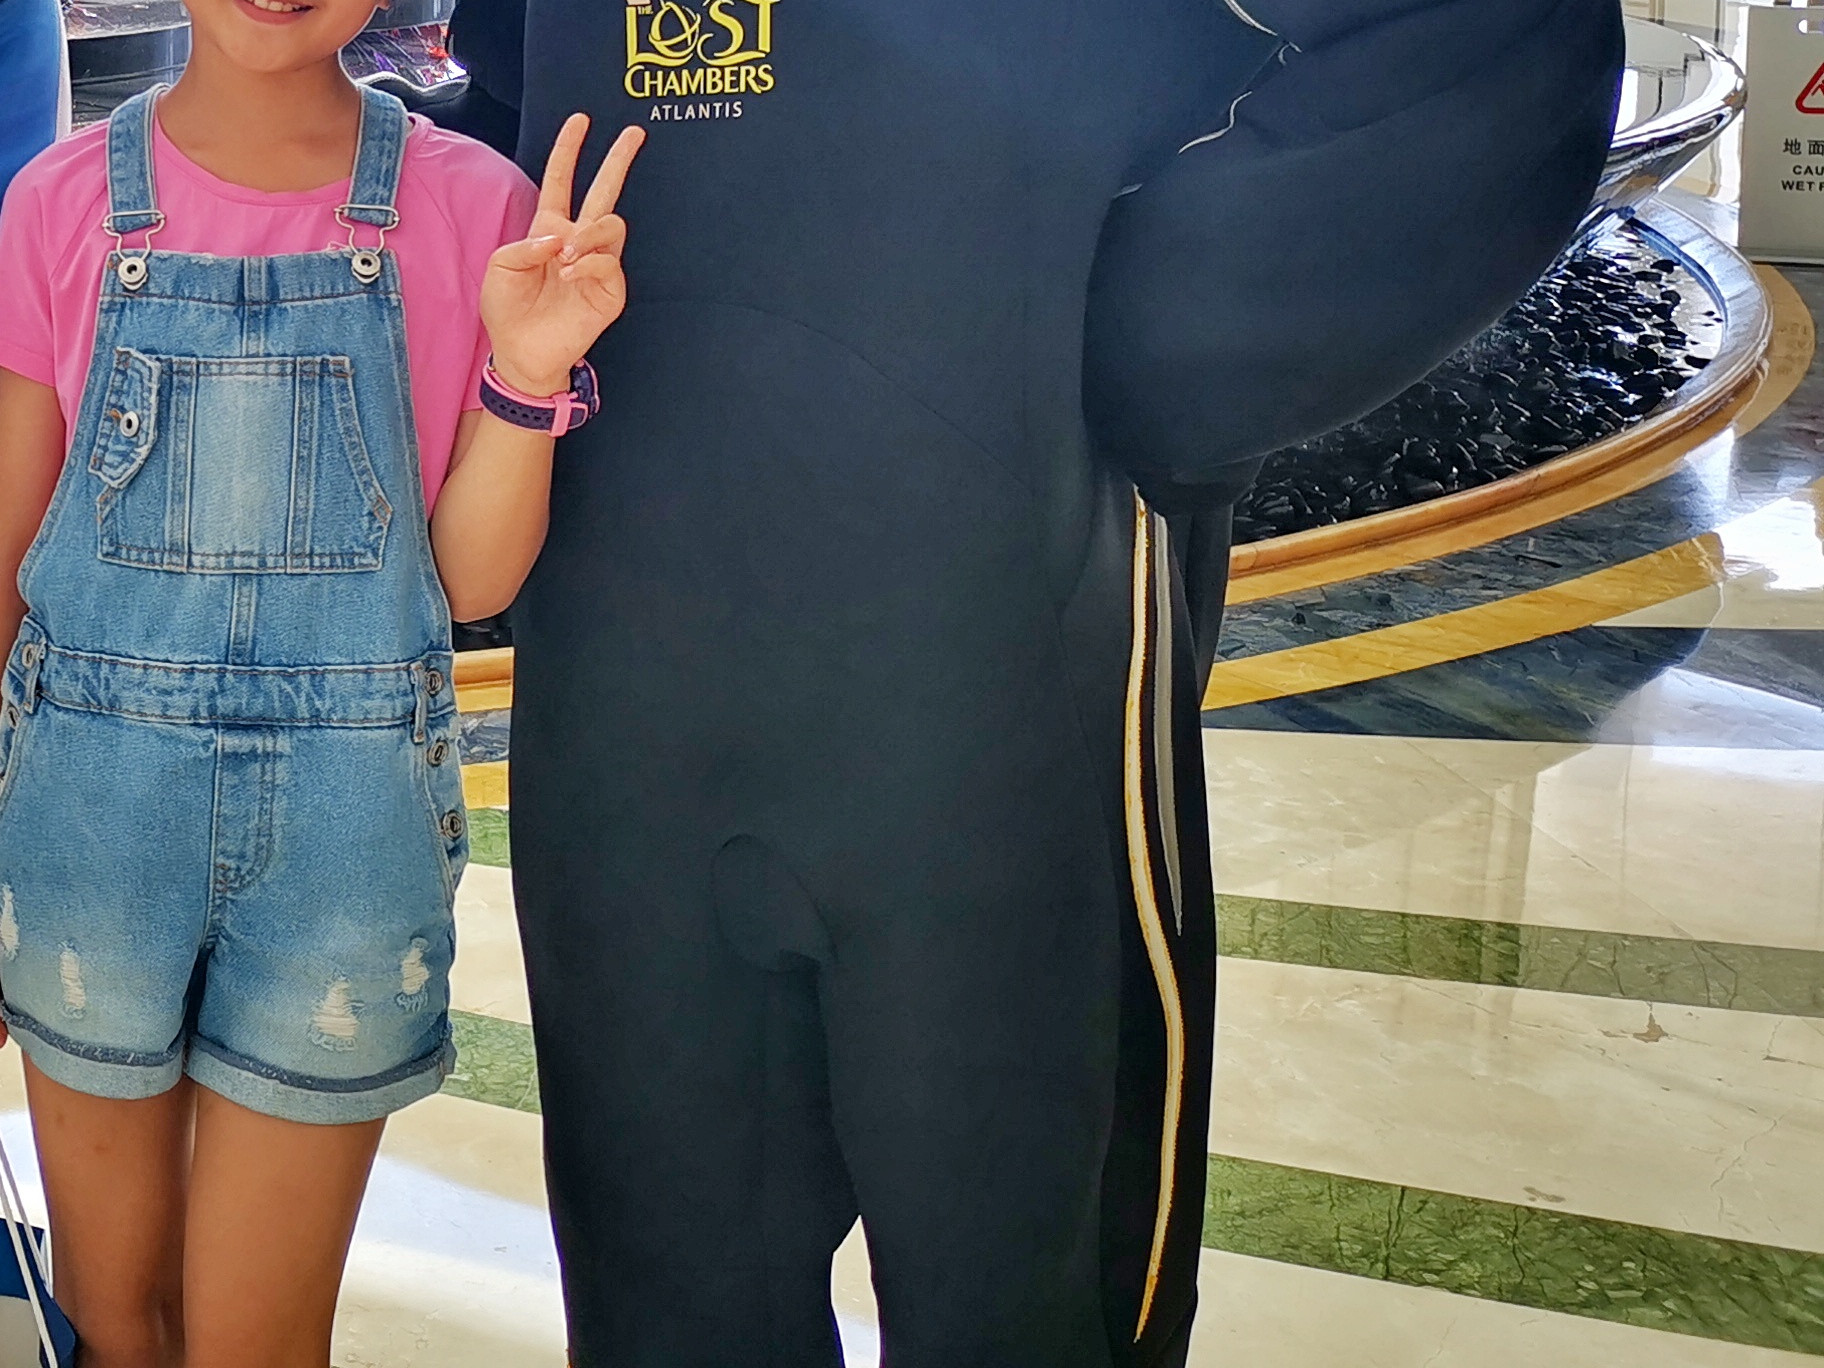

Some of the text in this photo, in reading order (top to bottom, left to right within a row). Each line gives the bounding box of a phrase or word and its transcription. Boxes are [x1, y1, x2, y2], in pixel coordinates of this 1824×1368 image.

[624, 63, 776, 99] CHAMBERS
[649, 100, 744, 122] ATLANTIS
[1782, 137, 1824, 156] 地面
[1781, 180, 1816, 192] WET
